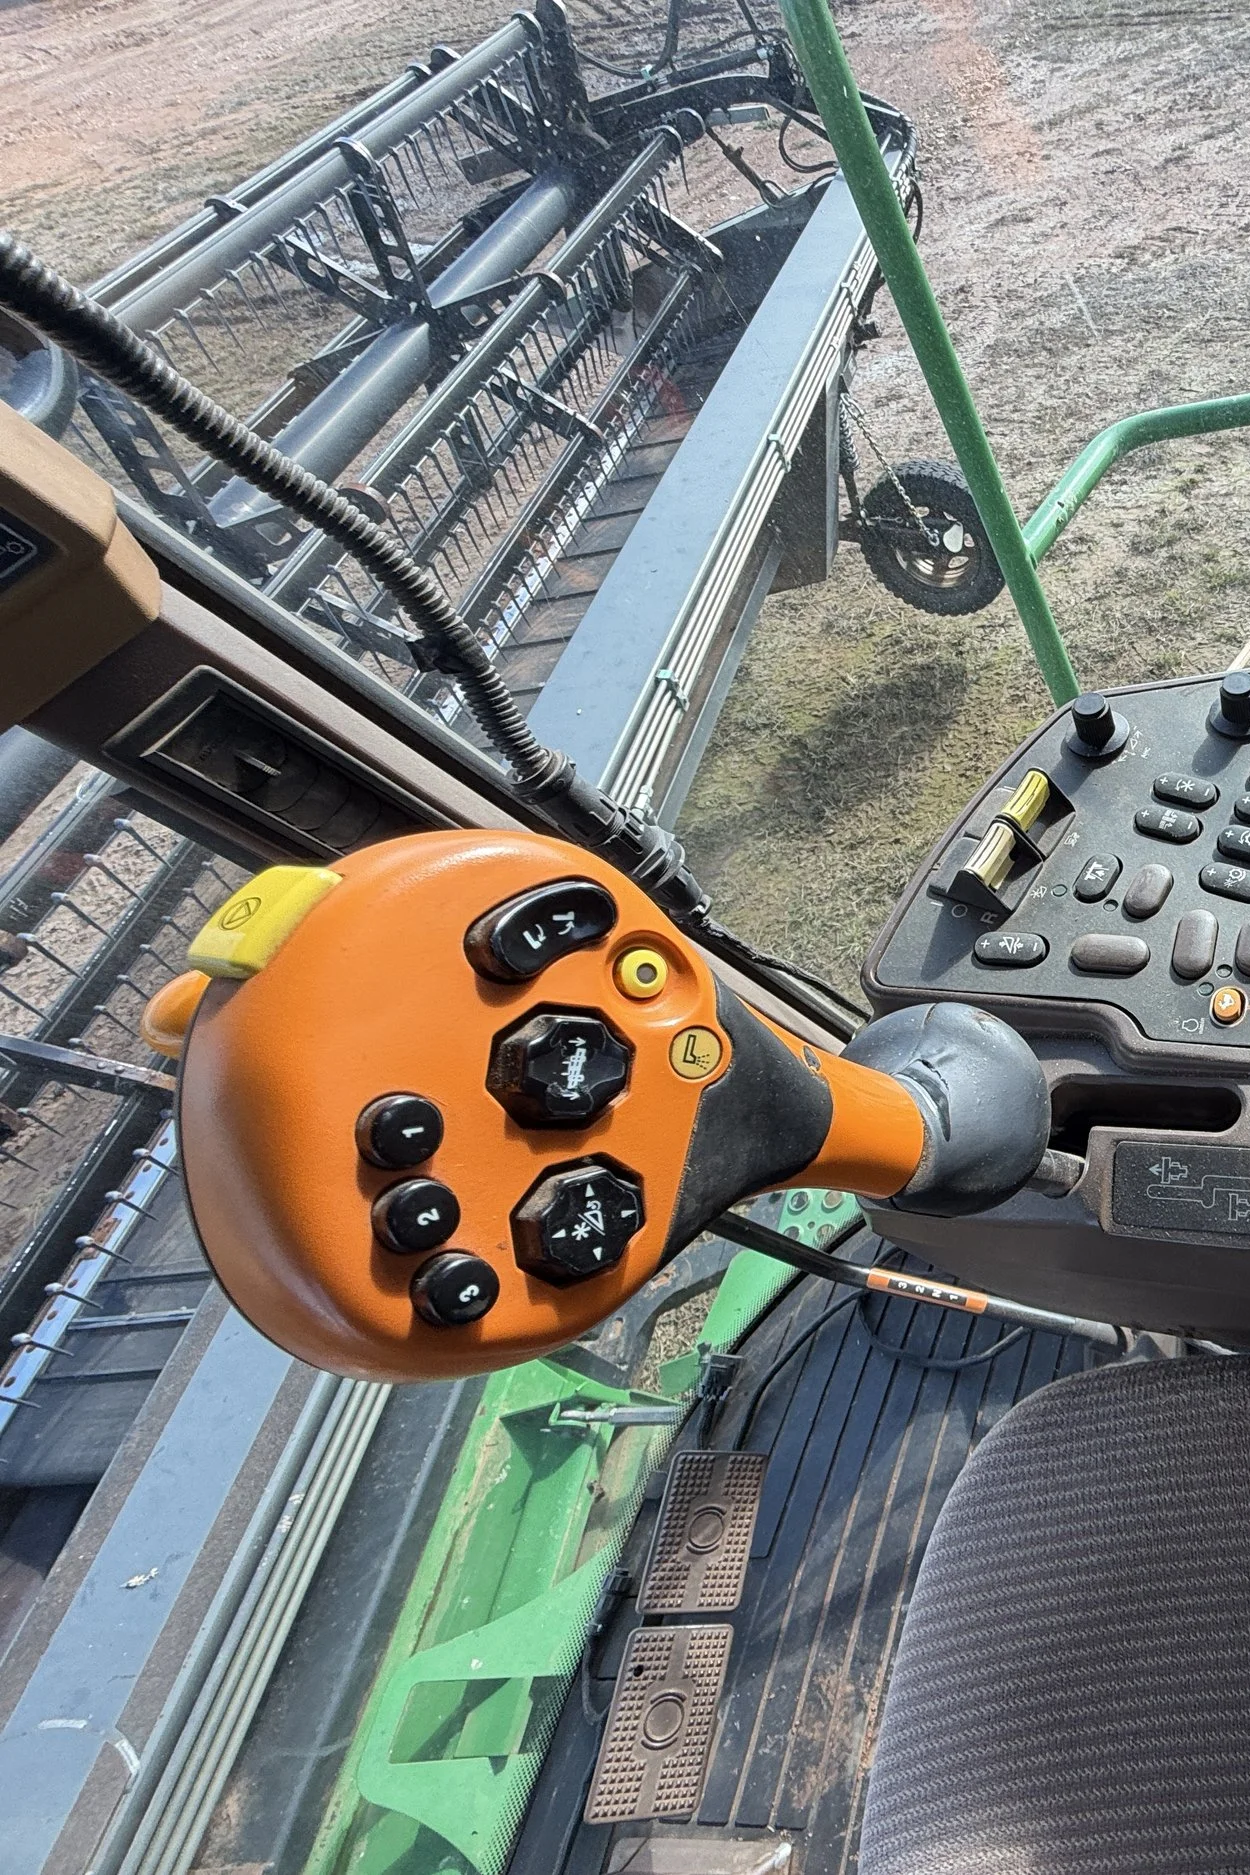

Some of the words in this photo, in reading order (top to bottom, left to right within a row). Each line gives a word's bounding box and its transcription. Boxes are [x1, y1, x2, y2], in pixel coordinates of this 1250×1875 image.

[980, 911, 998, 925] R
[401, 1126, 425, 1139] 1
[416, 1207, 441, 1227] 2
[458, 1284, 480, 1303] 3
[897, 1281, 908, 1290] 3
[914, 1285, 925, 1294] 2
